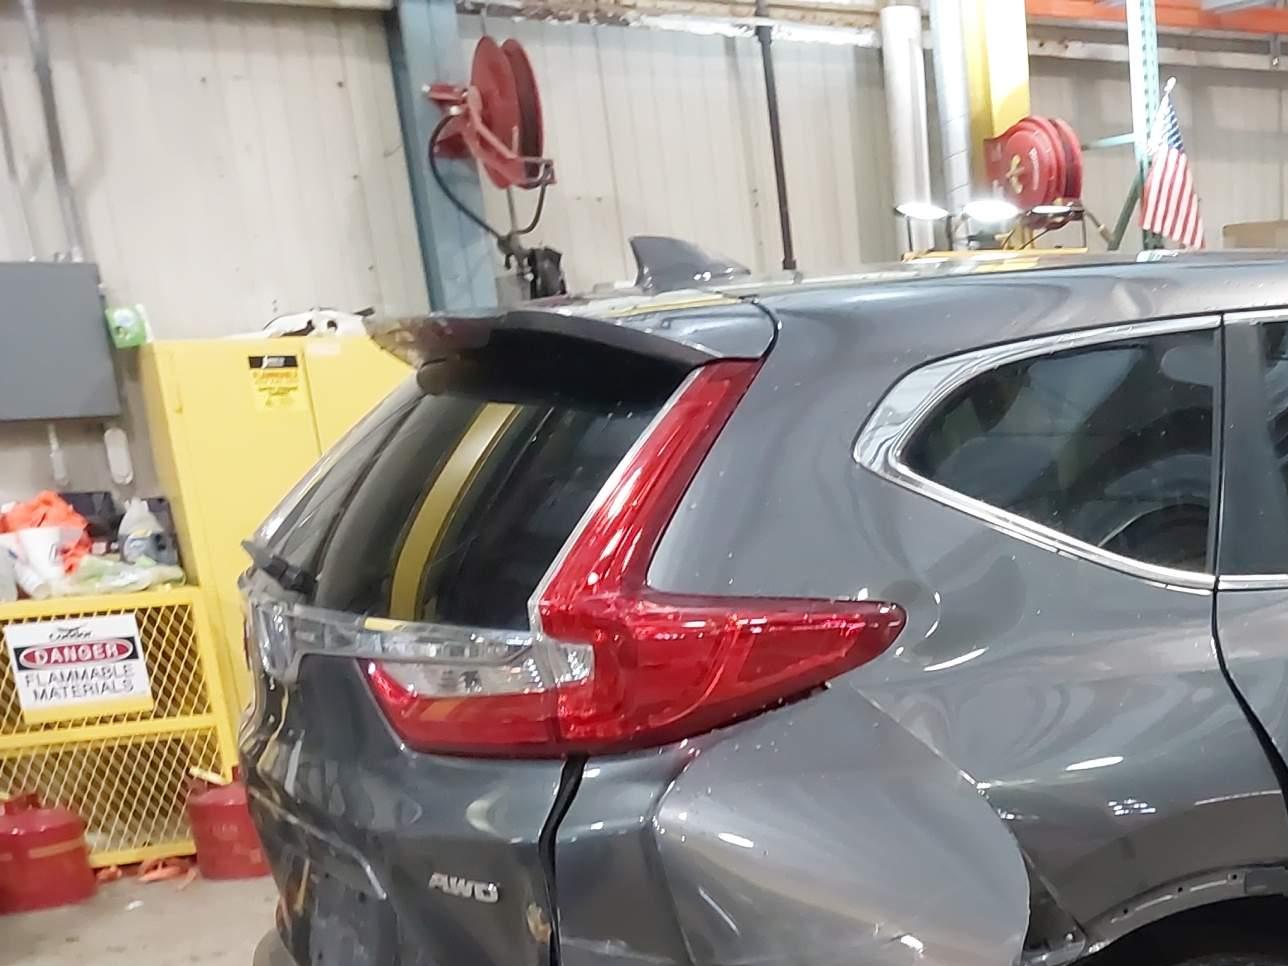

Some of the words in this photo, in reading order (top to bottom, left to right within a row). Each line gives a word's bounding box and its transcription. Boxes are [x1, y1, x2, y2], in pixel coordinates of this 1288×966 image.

[33, 642, 119, 665] DANGER
[25, 664, 135, 687] FLAMMABLE
[33, 680, 135, 701] MATERIALS
[429, 872, 499, 903] AWD
